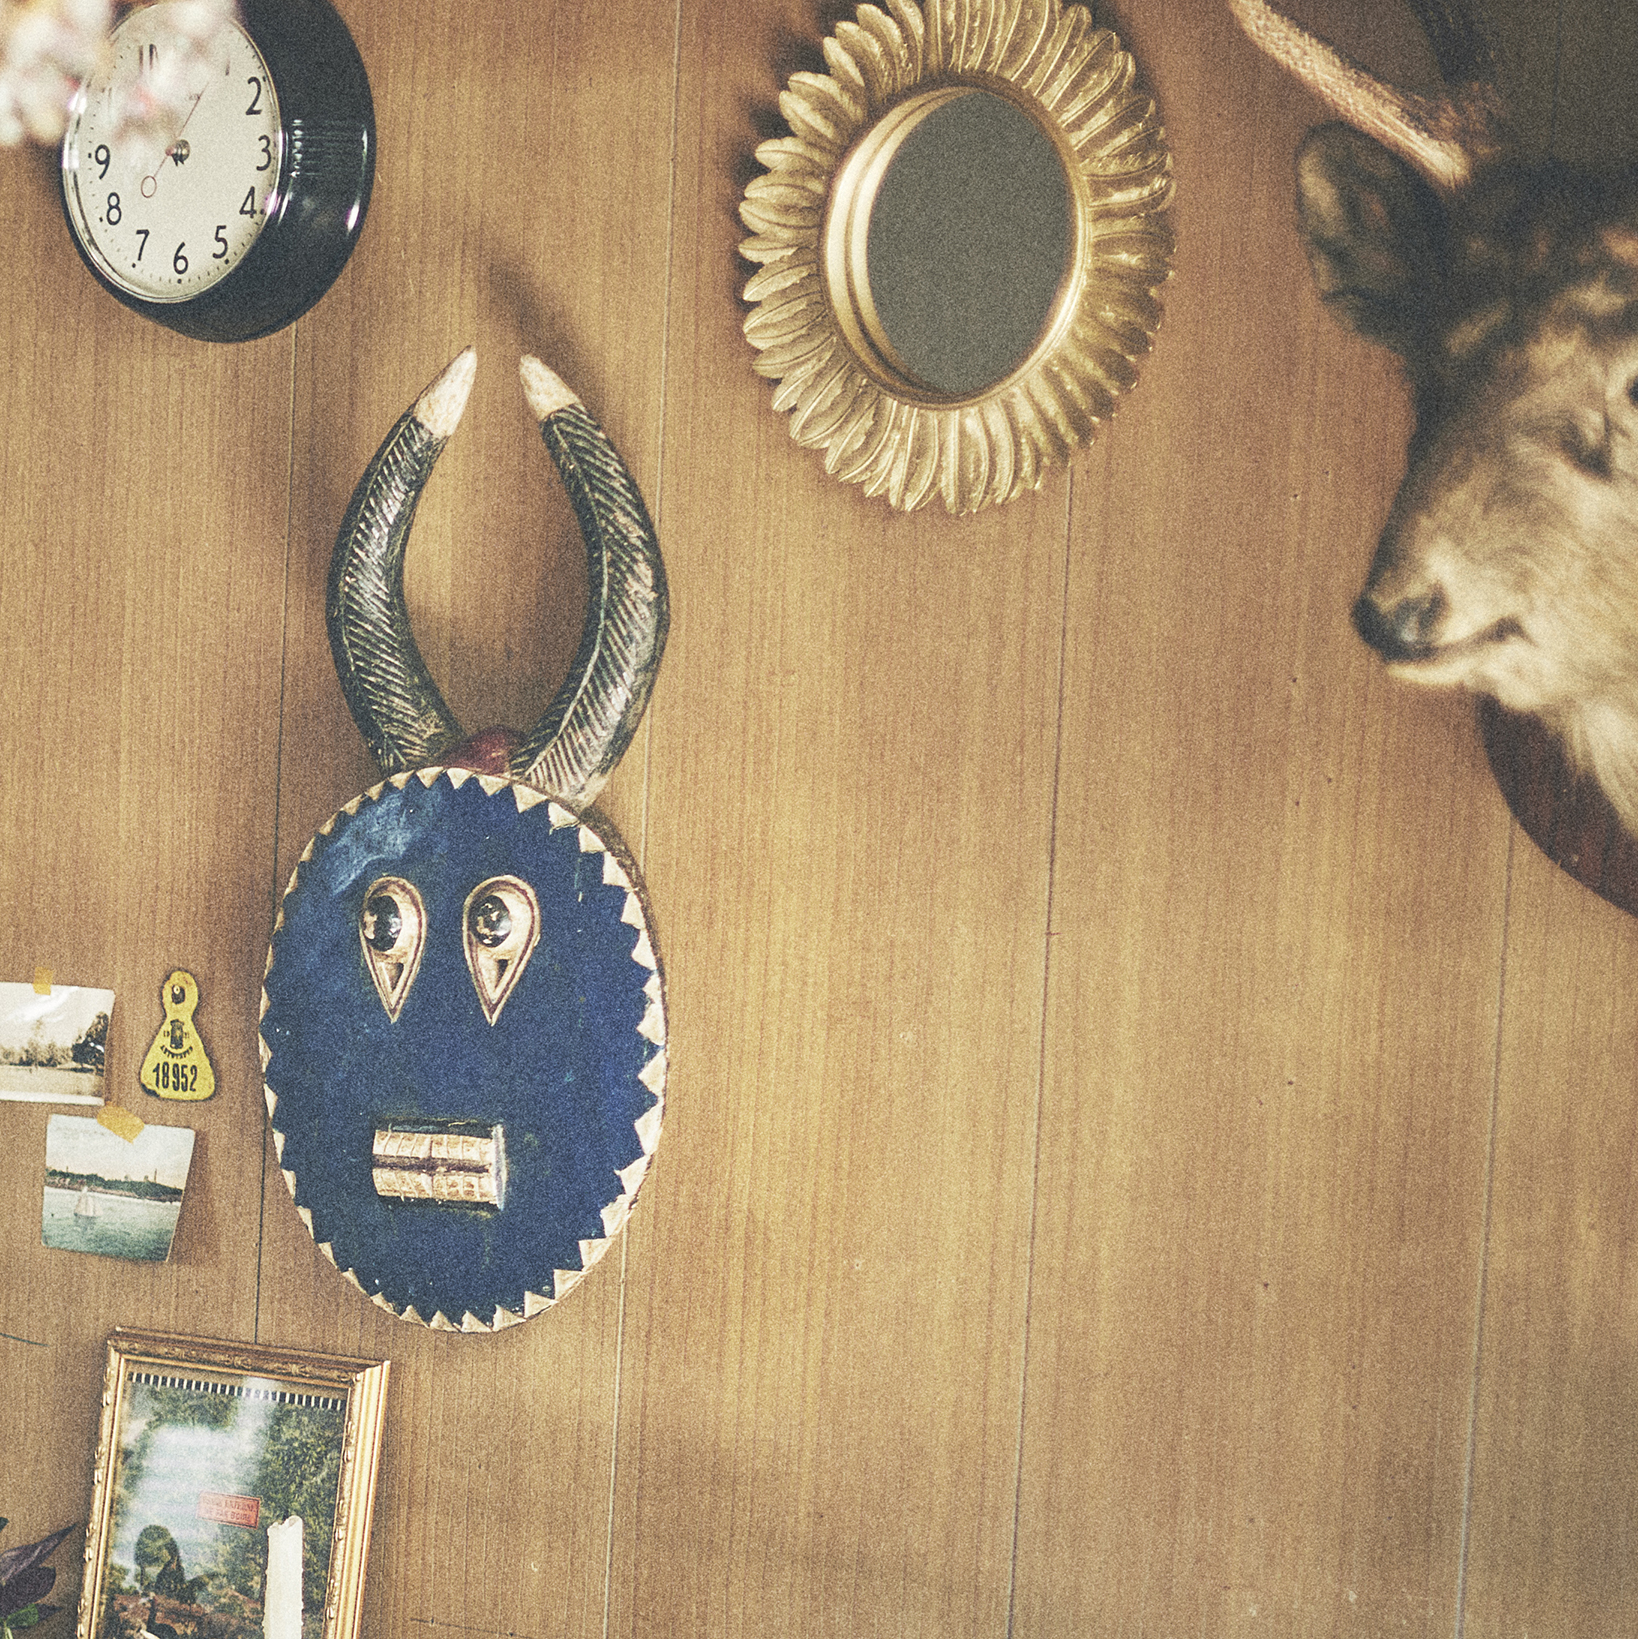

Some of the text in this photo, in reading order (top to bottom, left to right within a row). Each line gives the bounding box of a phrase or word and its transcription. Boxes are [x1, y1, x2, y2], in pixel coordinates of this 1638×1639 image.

[245, 76, 263, 115] 2
[94, 144, 111, 180] 9
[256, 134, 272, 171] 3
[106, 191, 122, 226] 8
[239, 186, 257, 218] 4
[135, 229, 150, 261] 7
[173, 241, 189, 275] 6
[212, 225, 229, 259] 5
[152, 1061, 198, 1093] 18952
